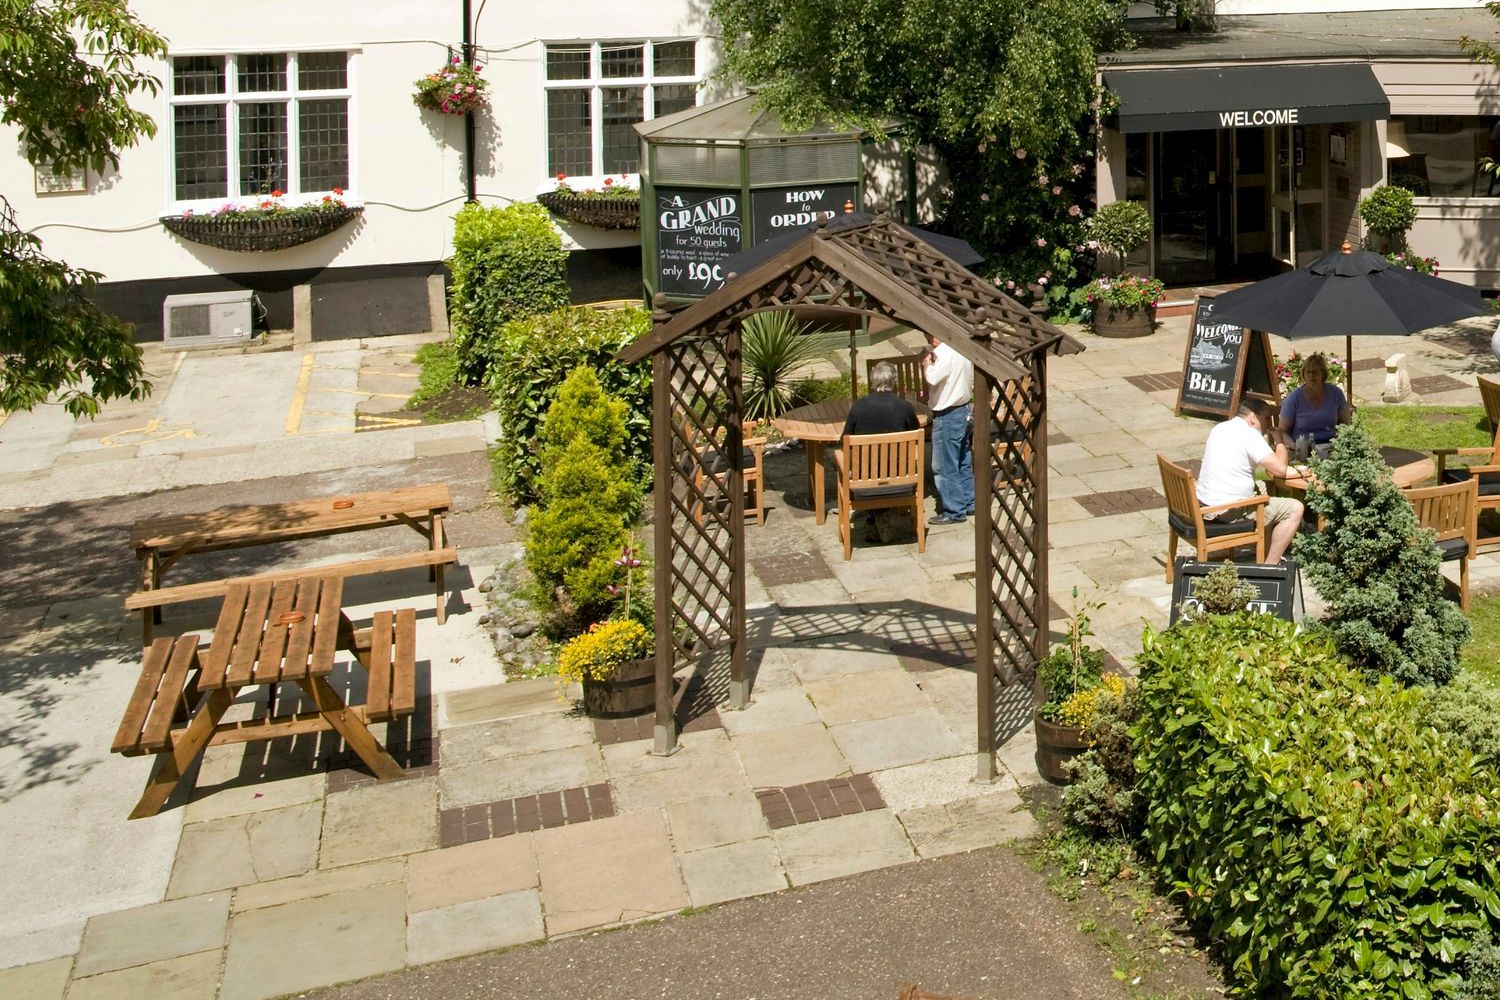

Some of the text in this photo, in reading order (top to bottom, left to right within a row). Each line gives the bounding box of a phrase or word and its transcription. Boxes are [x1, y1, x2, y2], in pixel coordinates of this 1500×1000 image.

[1219, 109, 1299, 127] WELCOME
[671, 195, 684, 207] A
[786, 190, 825, 203] HOW
[660, 196, 737, 230] GRAND
[802, 203, 811, 212] to
[694, 221, 740, 243] wedding
[675, 234, 727, 249] for 50 guests
[662, 264, 683, 281] only
[1225, 349, 1234, 360] to
[1189, 371, 1230, 395] BELL
